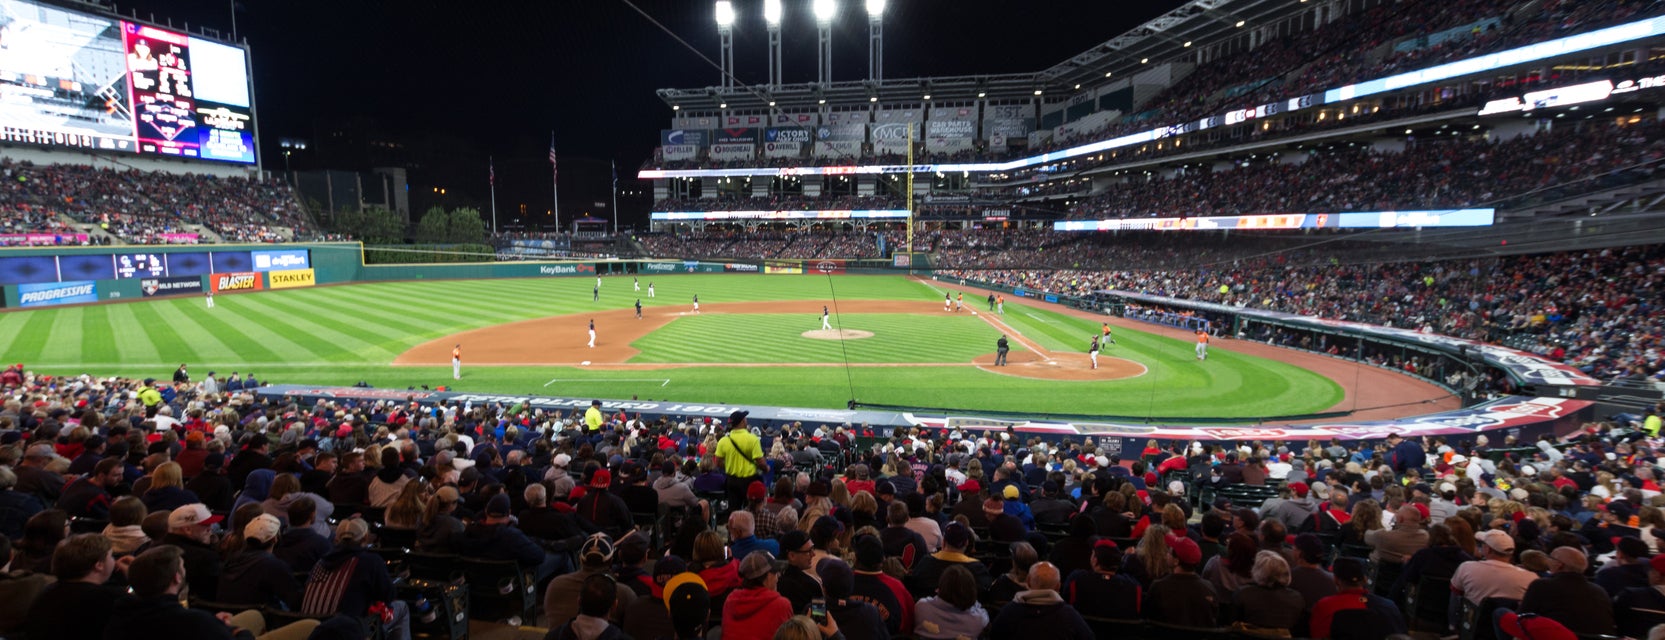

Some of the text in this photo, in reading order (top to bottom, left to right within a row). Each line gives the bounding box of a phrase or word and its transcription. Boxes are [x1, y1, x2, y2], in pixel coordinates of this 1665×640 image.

[540, 265, 576, 274] KeyBank
[218, 275, 255, 290] BLASTER
[272, 273, 312, 284] STANLEY
[173, 281, 201, 289] NETWORK
[21, 284, 94, 304] PROGRESSIVE
